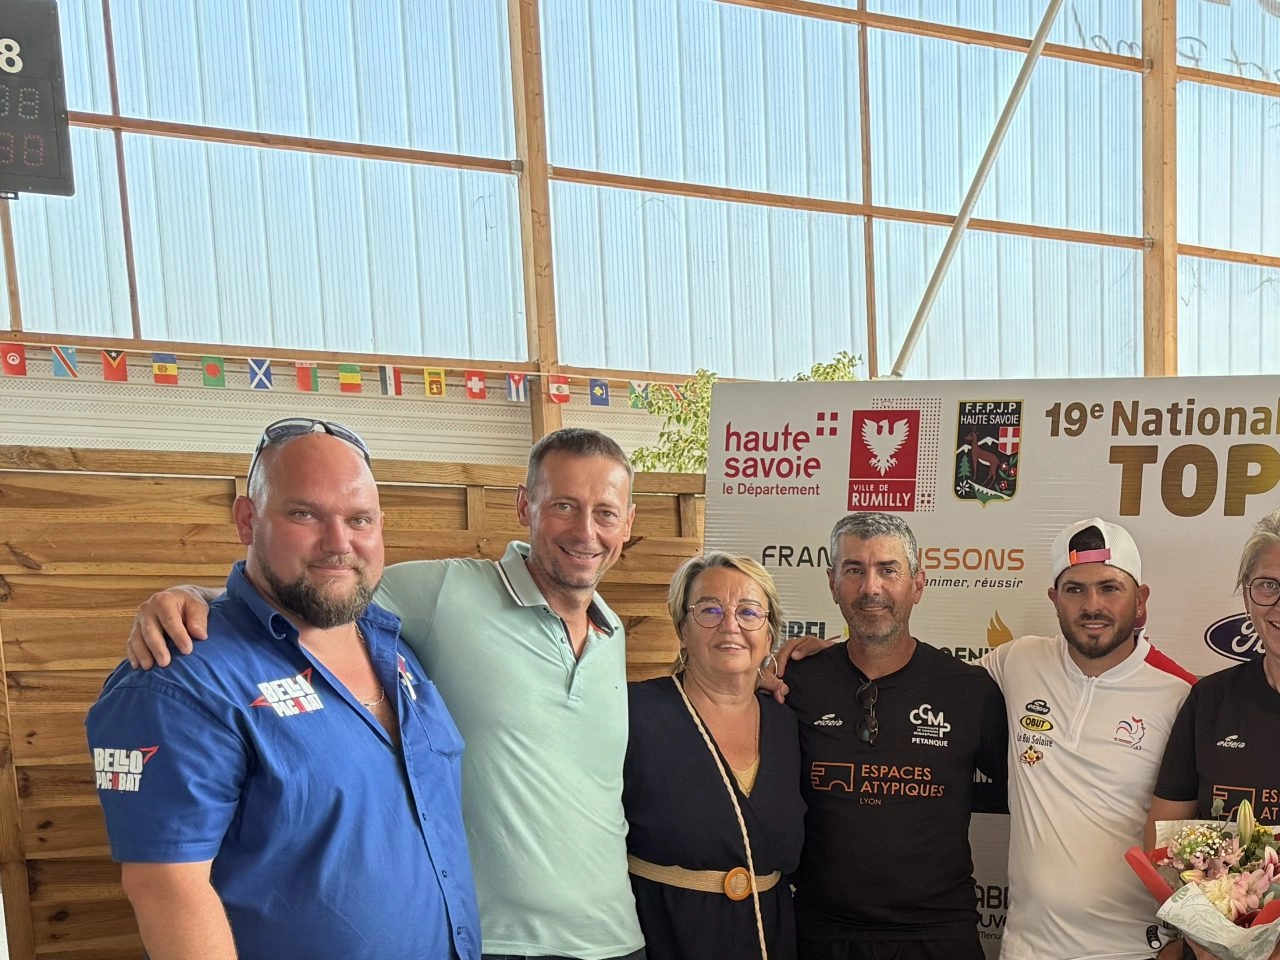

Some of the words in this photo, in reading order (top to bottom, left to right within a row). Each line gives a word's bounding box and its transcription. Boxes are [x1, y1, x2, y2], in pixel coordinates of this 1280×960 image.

[965, 402, 1016, 414] F.F.P.J.P
[960, 414, 988, 425] HAUTE
[990, 414, 1019, 425] SAVOIE
[1045, 402, 1104, 437] 19e
[725, 421, 810, 452] haute
[724, 455, 821, 478] savoie
[722, 483, 733, 495] le
[738, 483, 820, 497] Département
[853, 484, 876, 492] VILLE
[879, 484, 888, 492] DE
[852, 493, 912, 507] RUMILLY
[974, 577, 1023, 589] réussir
[1025, 717, 1046, 728] OBUT
[912, 737, 948, 747] PETANQUE
[1031, 735, 1053, 747] Solaire
[94, 748, 143, 773] BELLO
[861, 764, 932, 780] ESPACES
[860, 781, 945, 797] ATYPIQUES
